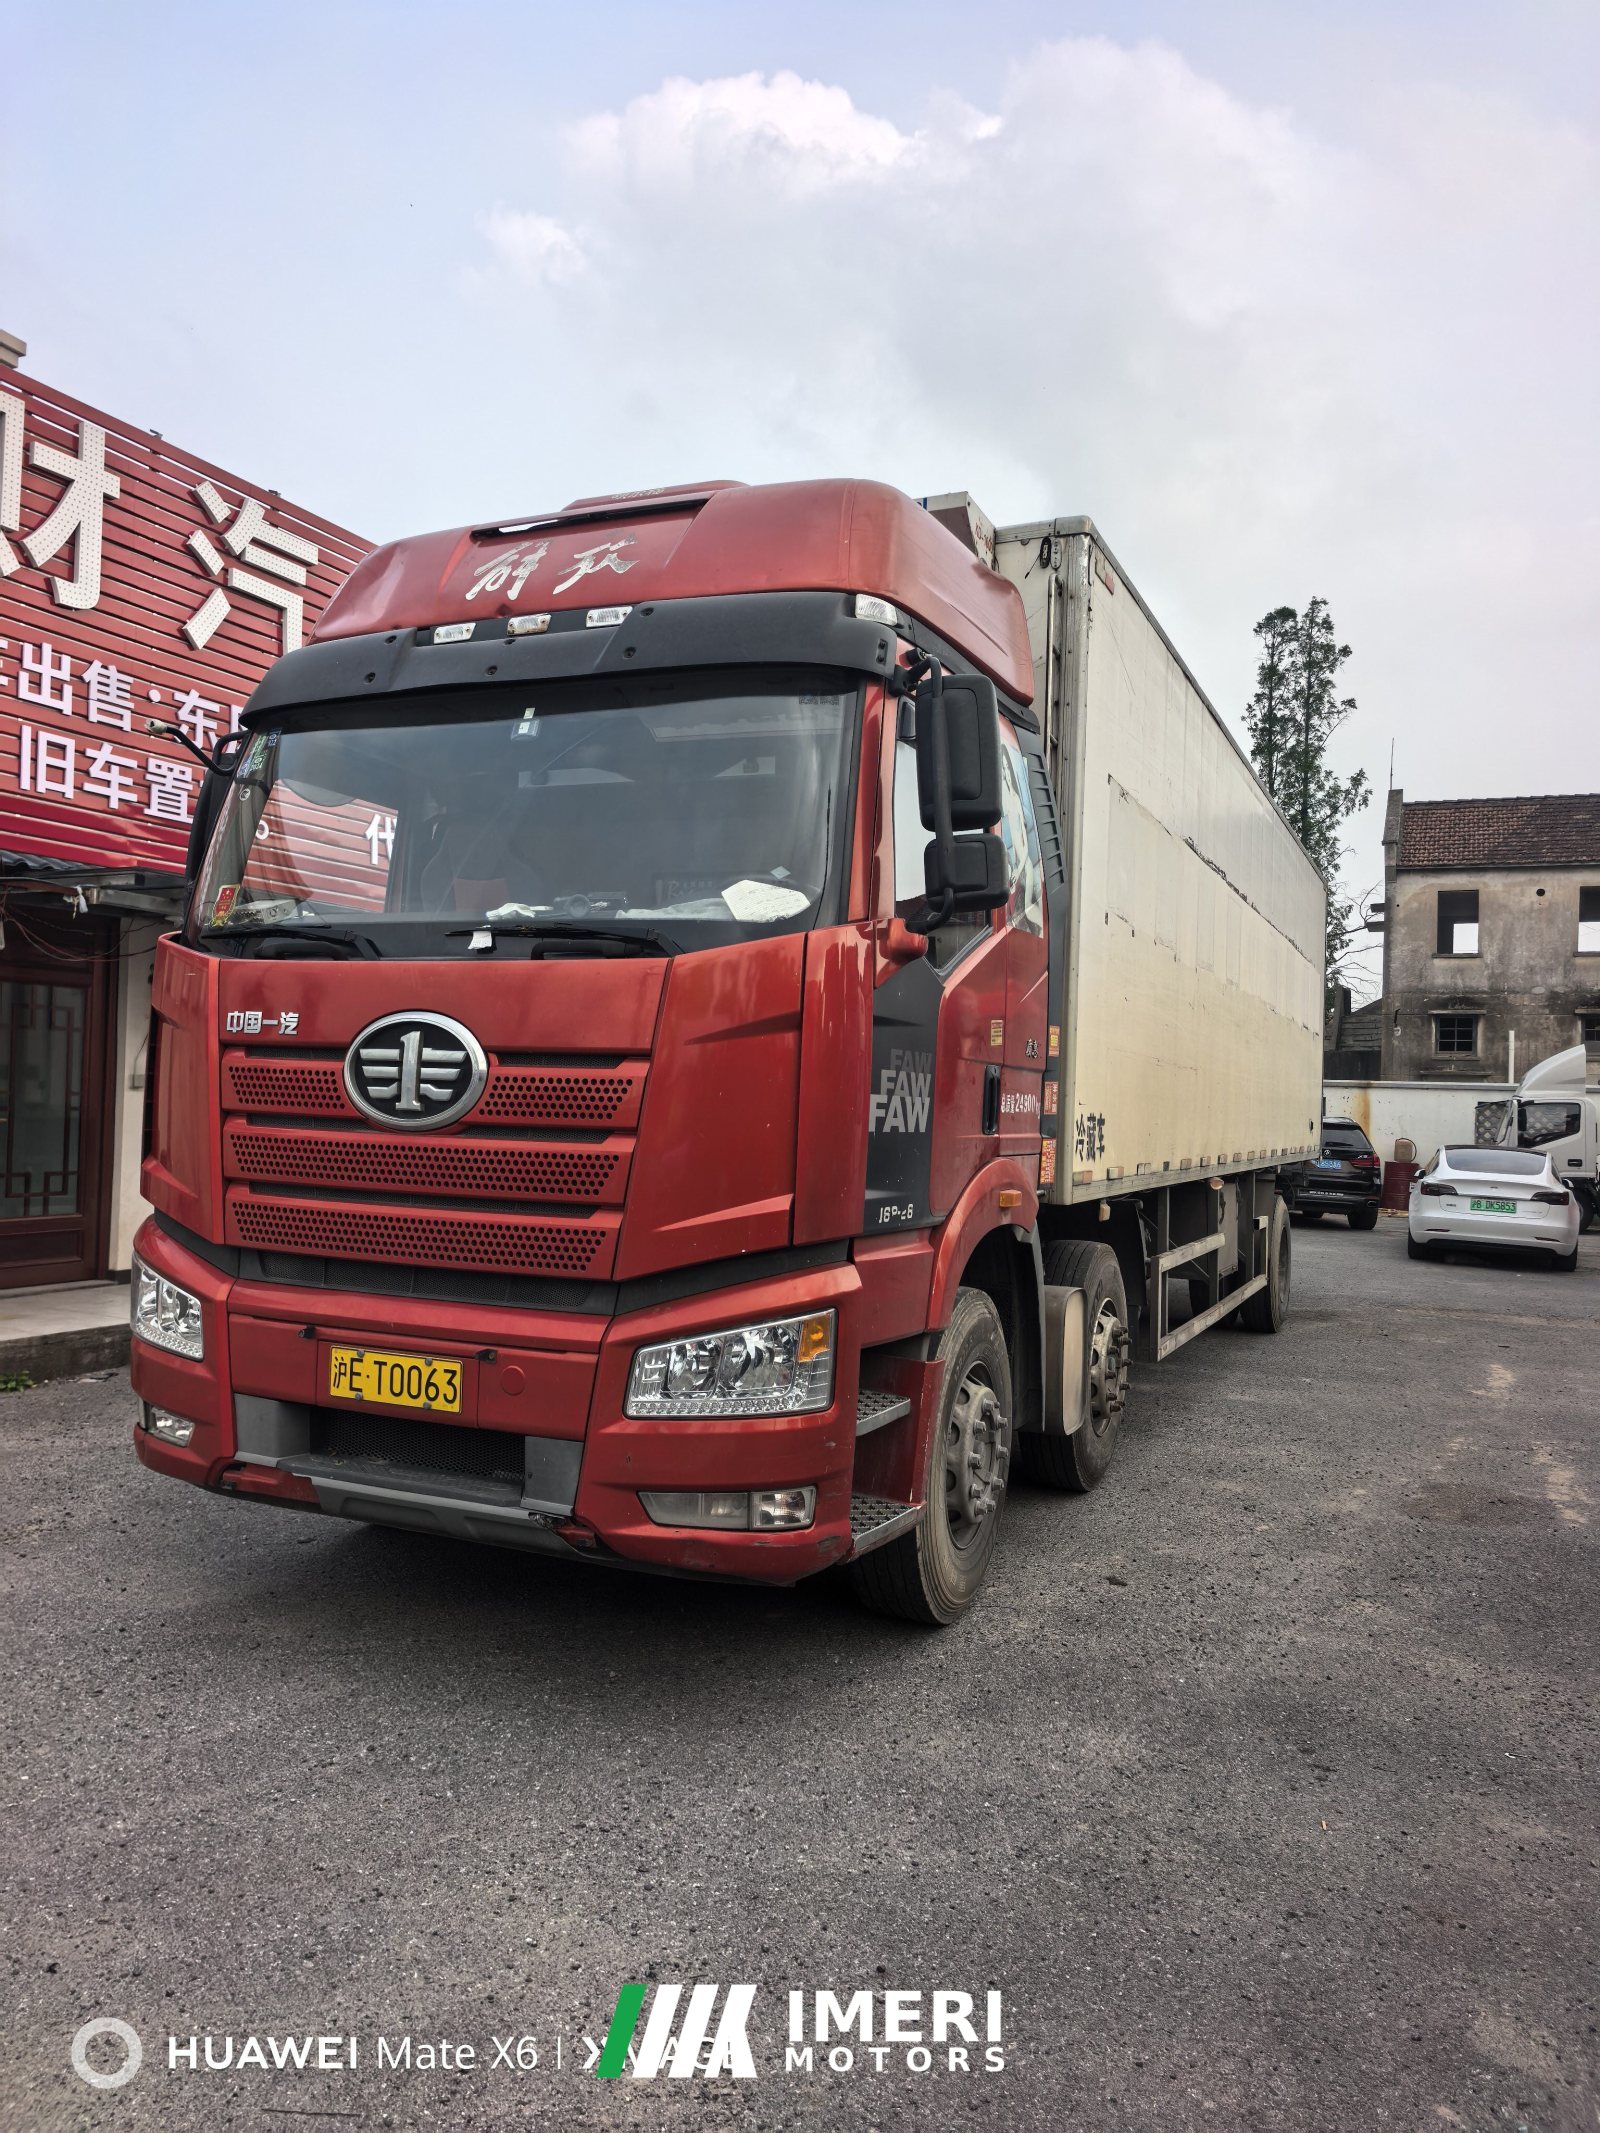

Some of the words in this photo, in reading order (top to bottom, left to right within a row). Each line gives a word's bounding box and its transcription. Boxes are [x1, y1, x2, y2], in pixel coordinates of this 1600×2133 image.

[226, 1010, 300, 1035] 中国一汽
[890, 1049, 933, 1075] FAW
[880, 1069, 932, 1099] FAW
[868, 1094, 931, 1133] FAW
[1075, 1113, 1105, 1163] 冷藏车
[333, 1356, 458, 1405] 沪E·T0063
